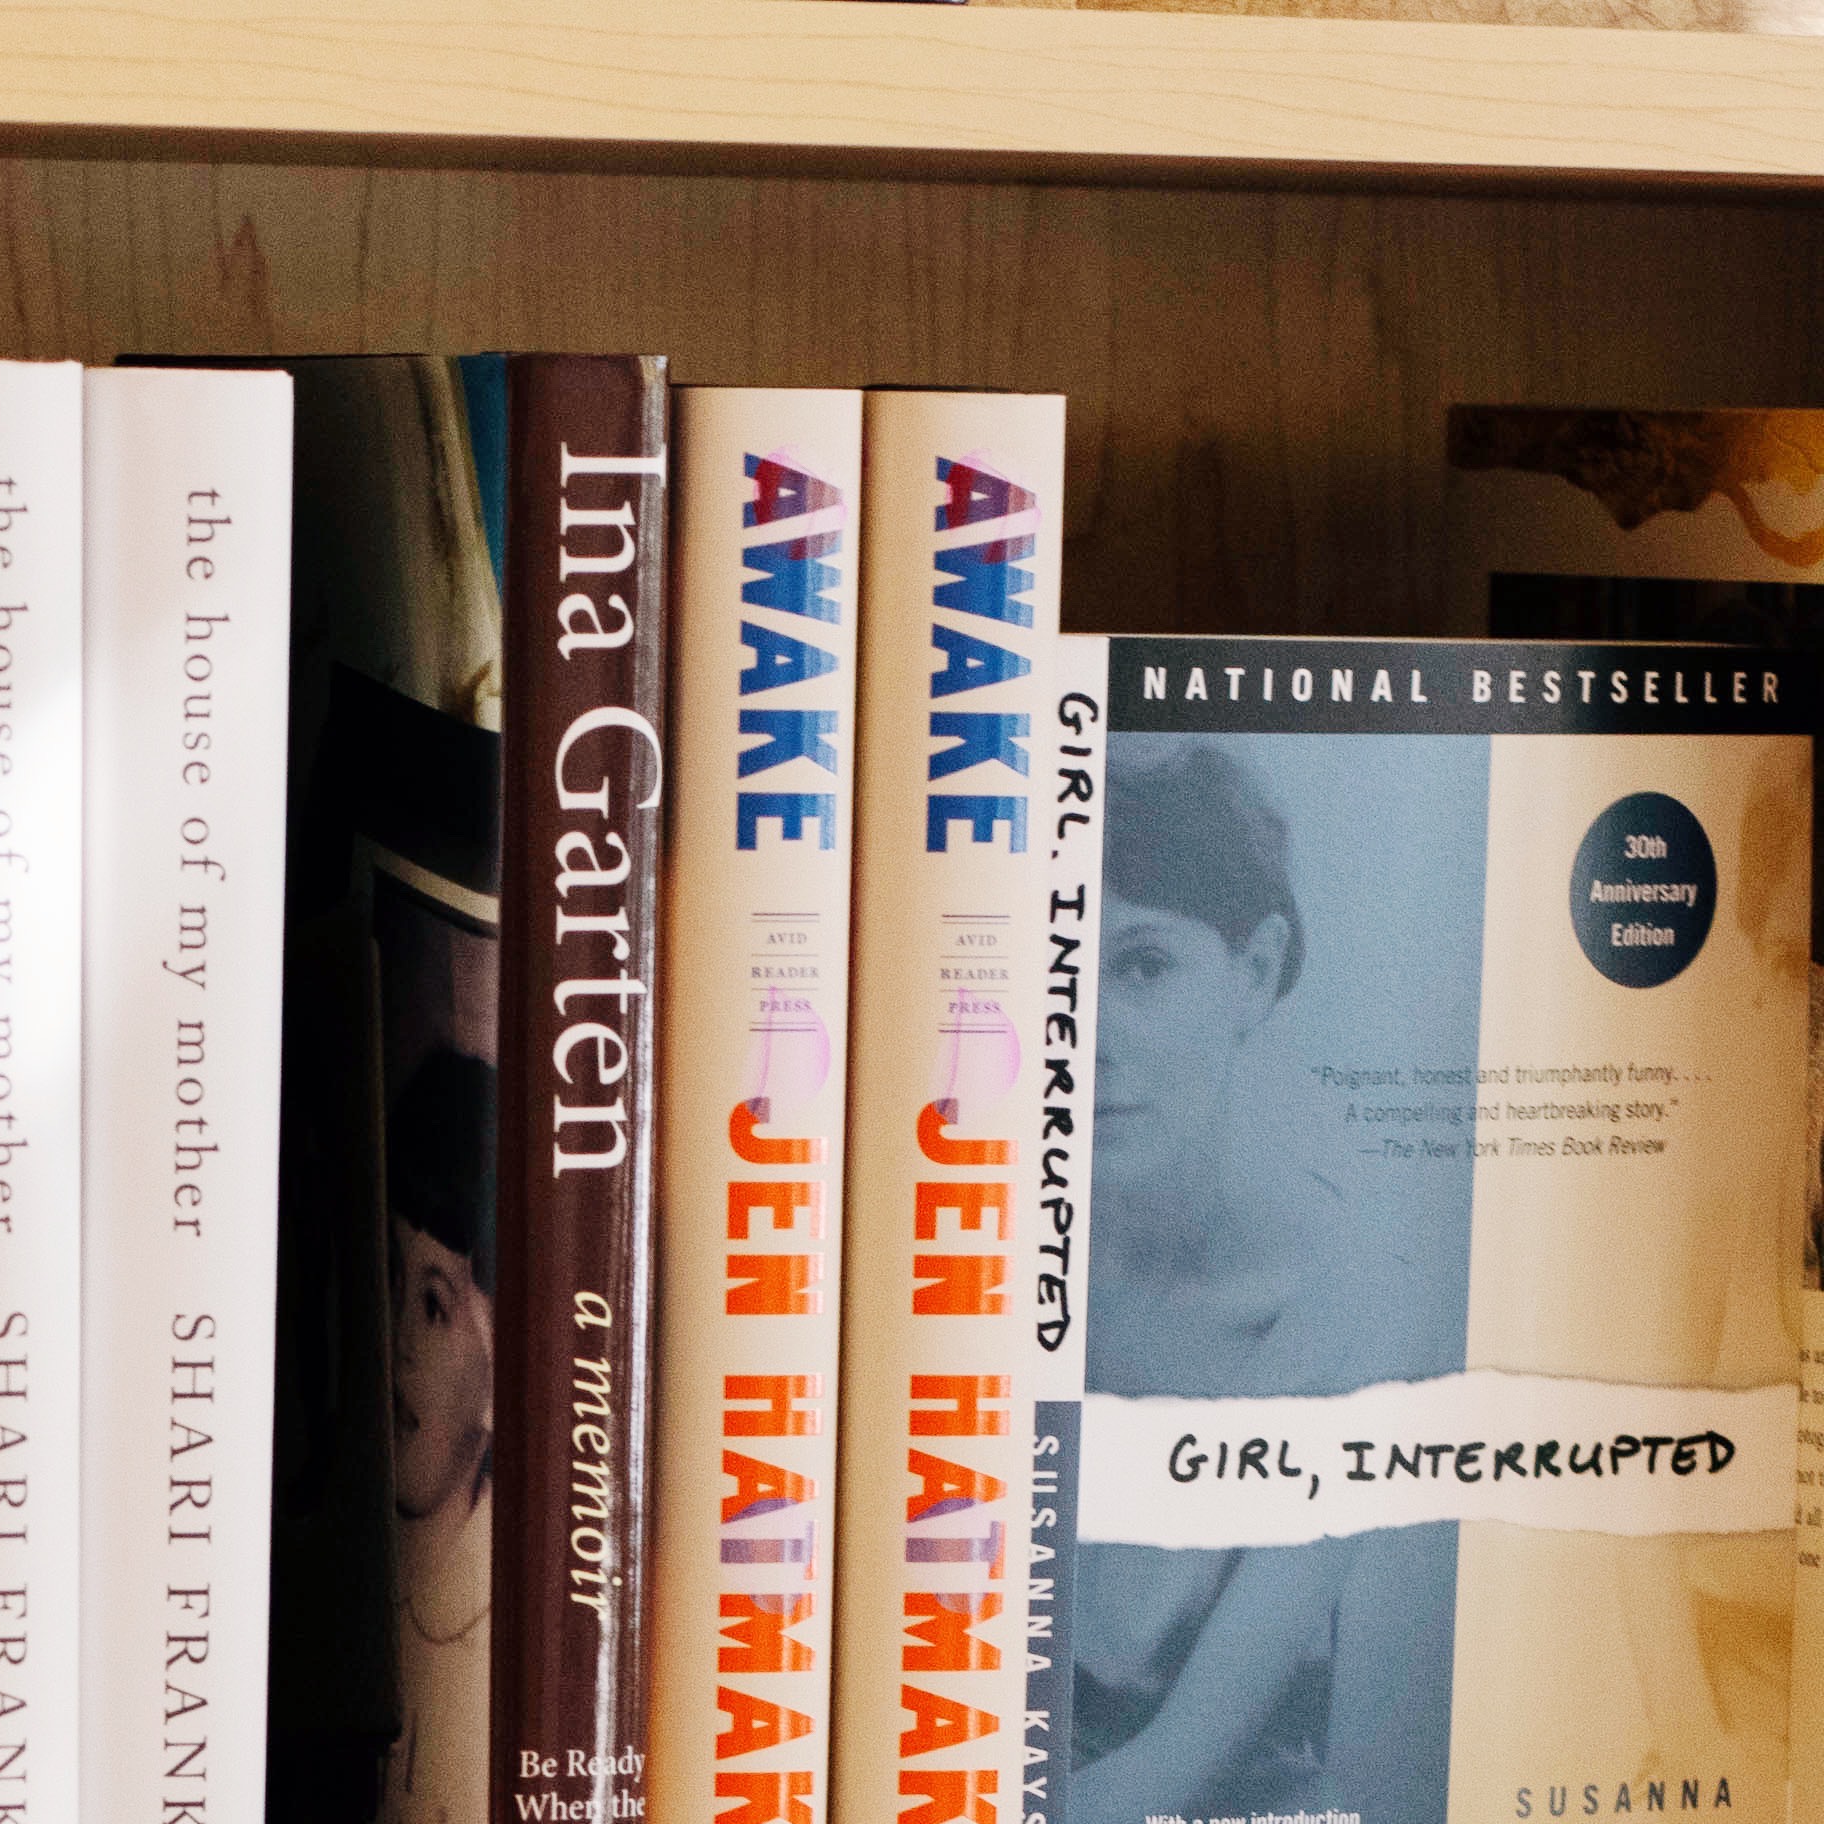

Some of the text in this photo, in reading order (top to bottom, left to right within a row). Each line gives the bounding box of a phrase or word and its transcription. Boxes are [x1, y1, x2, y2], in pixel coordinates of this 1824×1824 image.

[736, 452, 843, 852] AWAKE
[1144, 667, 1780, 704] NATIONAL BESTSELLER
[553, 443, 667, 1177] Ina Garten
[162, 488, 231, 1240] the house of my mother
[1625, 834, 1667, 860] 30th
[1590, 880, 1696, 907] Anniversary
[1612, 922, 1674, 948] Edition
[751, 966, 820, 980] READER
[759, 999, 813, 1013] PRESS
[726, 1097, 828, 1316] JEN
[170, 1313, 214, 1544] SHARI
[570, 1290, 623, 1622] a memoir
[1169, 1432, 1737, 1500] GIRL, INTERRUPTED
[1515, 1780, 1733, 1818] SUSANNA
